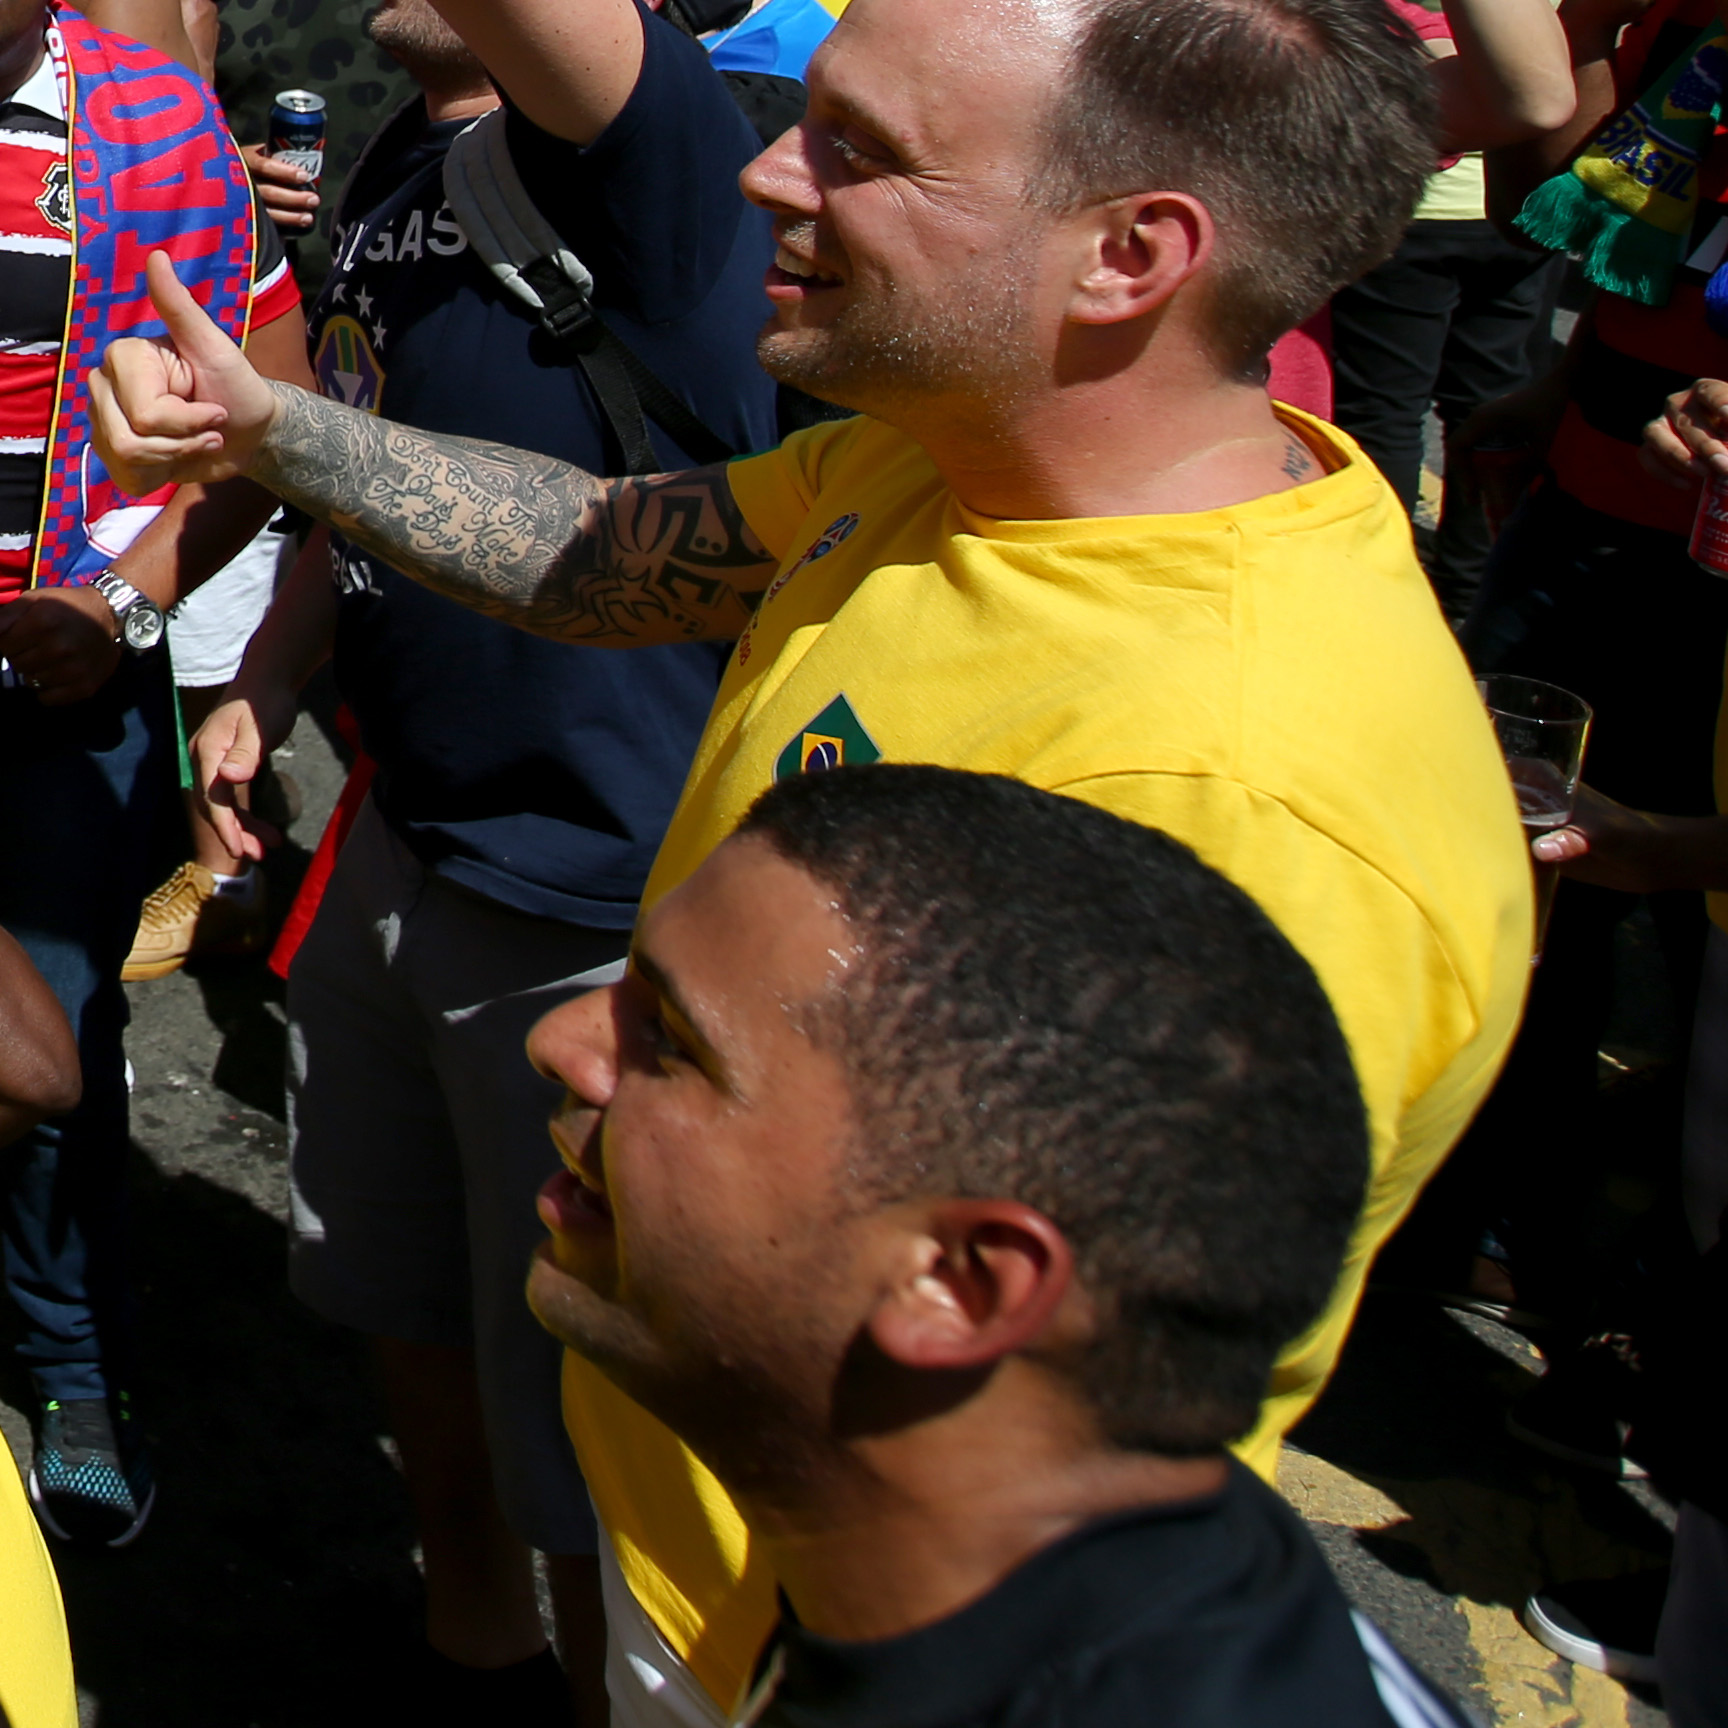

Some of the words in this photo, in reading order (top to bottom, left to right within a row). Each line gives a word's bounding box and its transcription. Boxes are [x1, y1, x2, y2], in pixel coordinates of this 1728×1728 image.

[1594, 114, 1697, 202] BRASIL
[390, 433, 443, 477] Don't
[444, 460, 500, 517] Count
